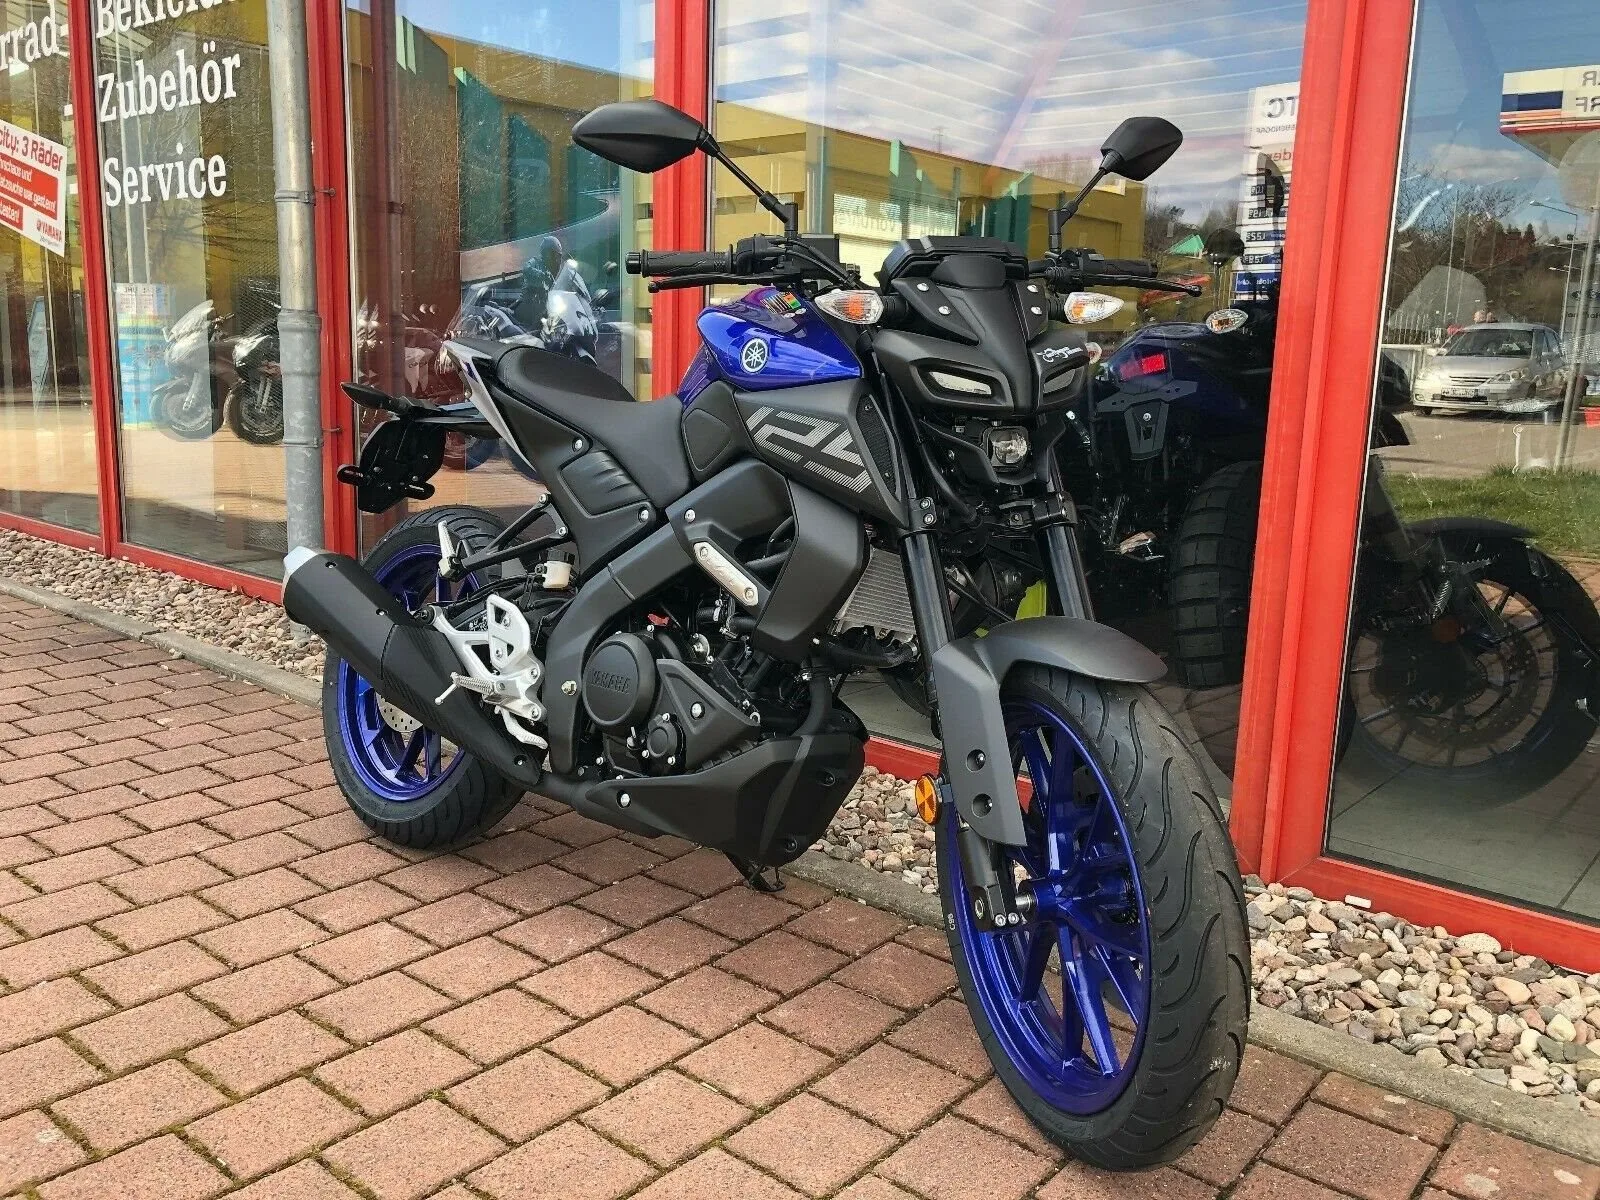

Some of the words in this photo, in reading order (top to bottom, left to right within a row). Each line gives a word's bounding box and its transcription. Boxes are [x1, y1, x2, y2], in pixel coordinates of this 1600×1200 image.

[98, 40, 241, 122] Zubehör
[22, 135, 29, 157] 3
[31, 141, 63, 171] Räder
[104, 142, 226, 207] Service
